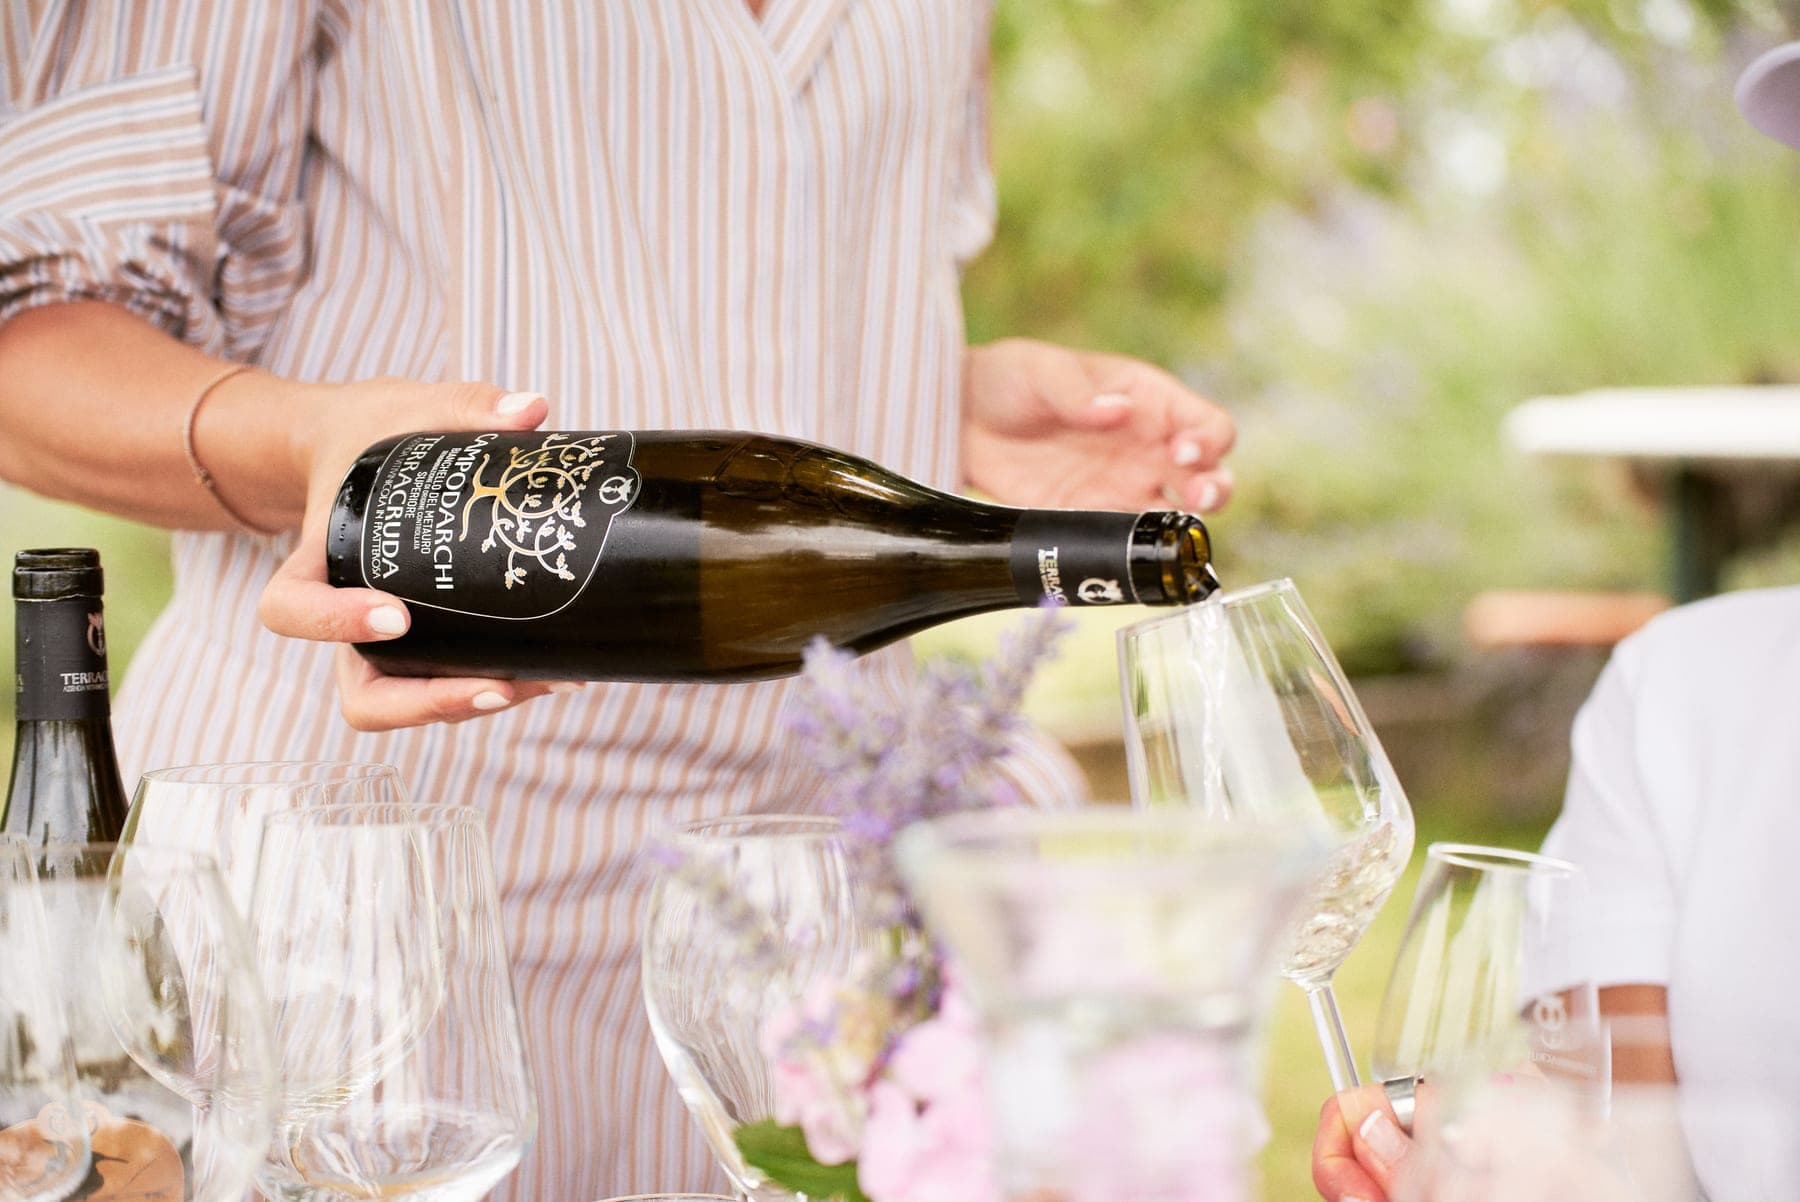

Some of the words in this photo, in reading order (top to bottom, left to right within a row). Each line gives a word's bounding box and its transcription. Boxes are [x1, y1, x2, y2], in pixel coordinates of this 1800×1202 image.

[431, 447, 462, 490] BIANCHELLO
[375, 509, 385, 519] IN
[381, 435, 445, 579] TERRACRUDA
[404, 471, 428, 519] SUPERIORE
[426, 491, 439, 509] DEL
[434, 433, 499, 589] CAMPODARCHI
[371, 521, 382, 580] FRATTEROSA
[413, 511, 424, 550] CONTROLLATA
[420, 510, 434, 555] METAURO
